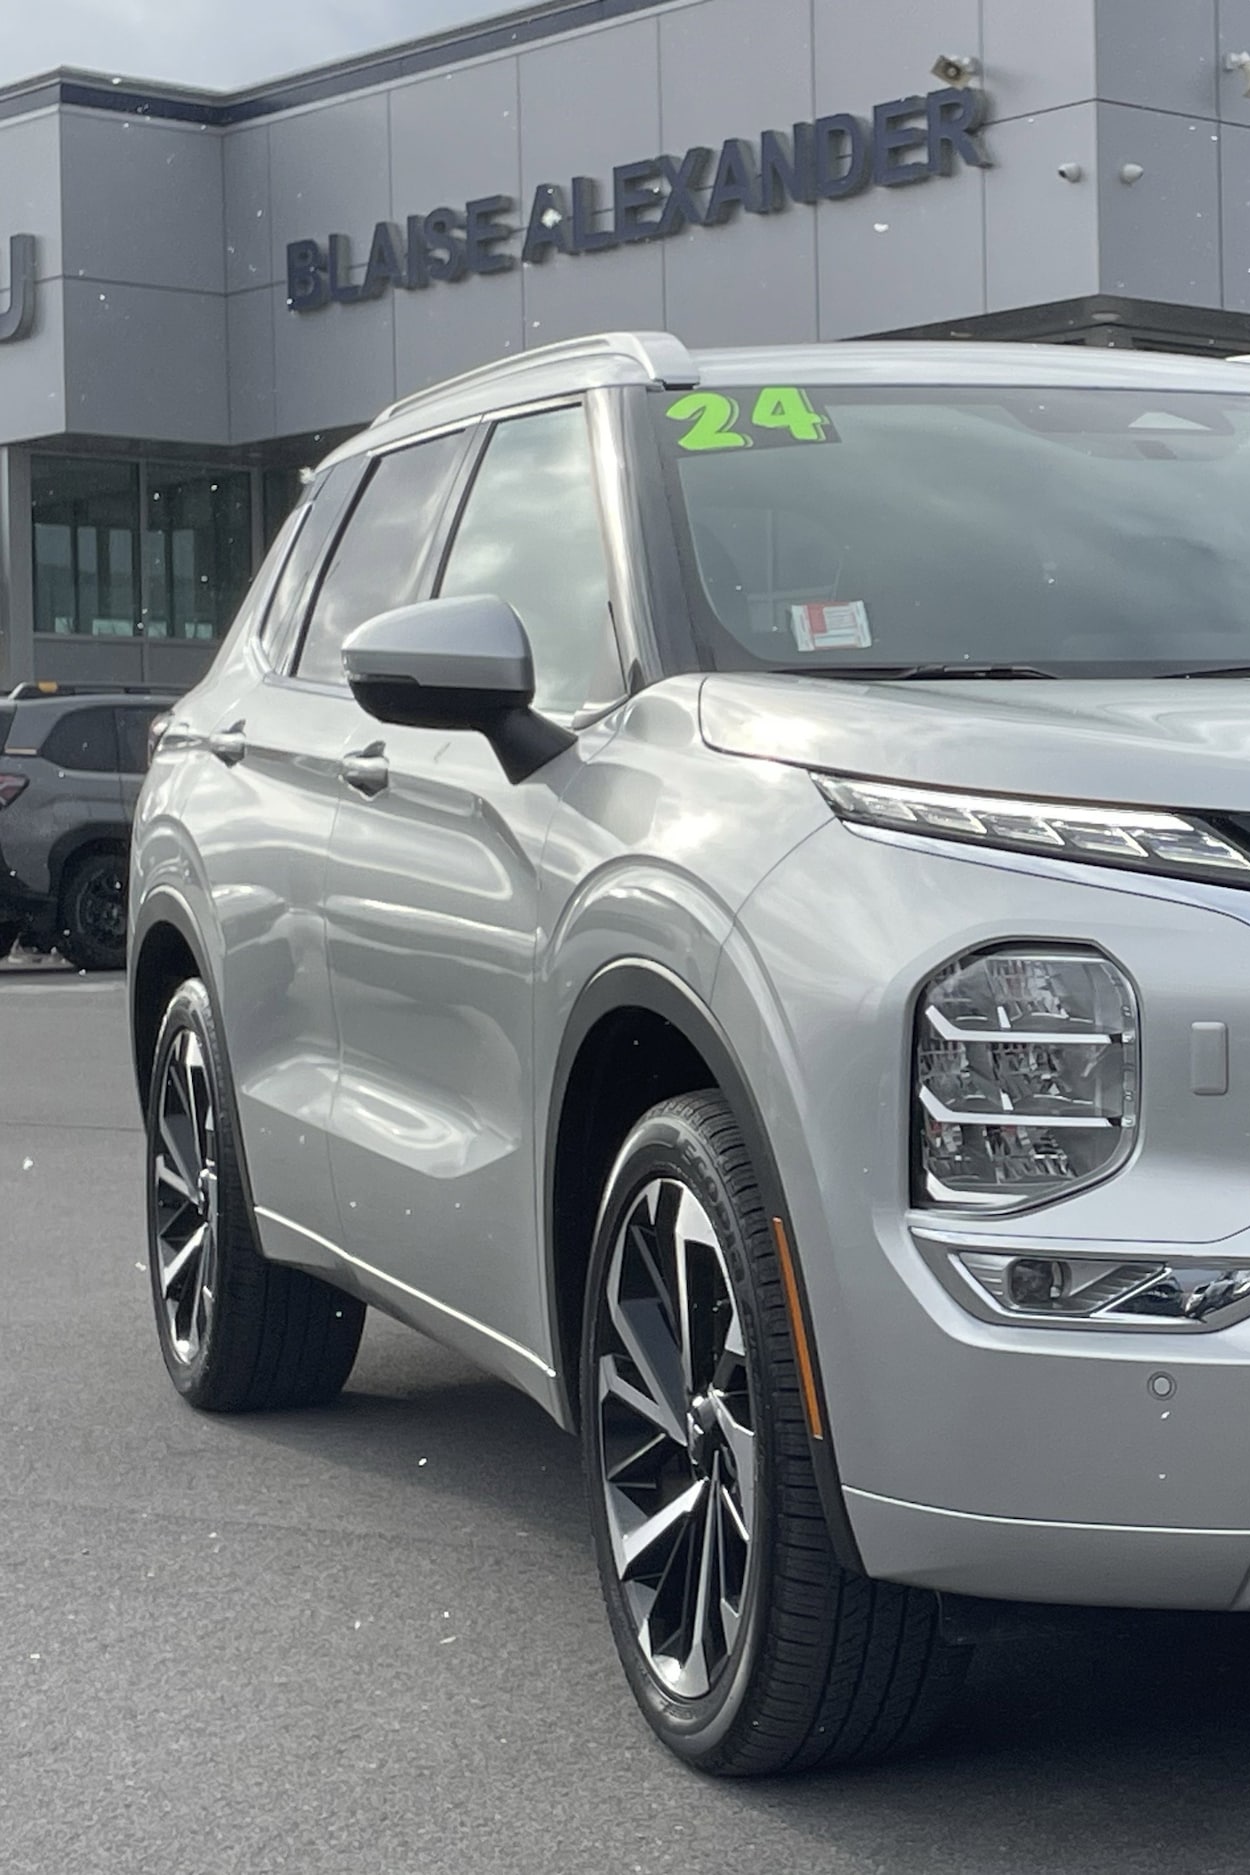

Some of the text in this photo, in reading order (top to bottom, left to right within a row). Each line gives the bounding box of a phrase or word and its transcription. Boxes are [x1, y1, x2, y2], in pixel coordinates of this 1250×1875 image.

[286, 86, 993, 314] BLAISE ALEXANDER
[666, 386, 829, 450] 24
